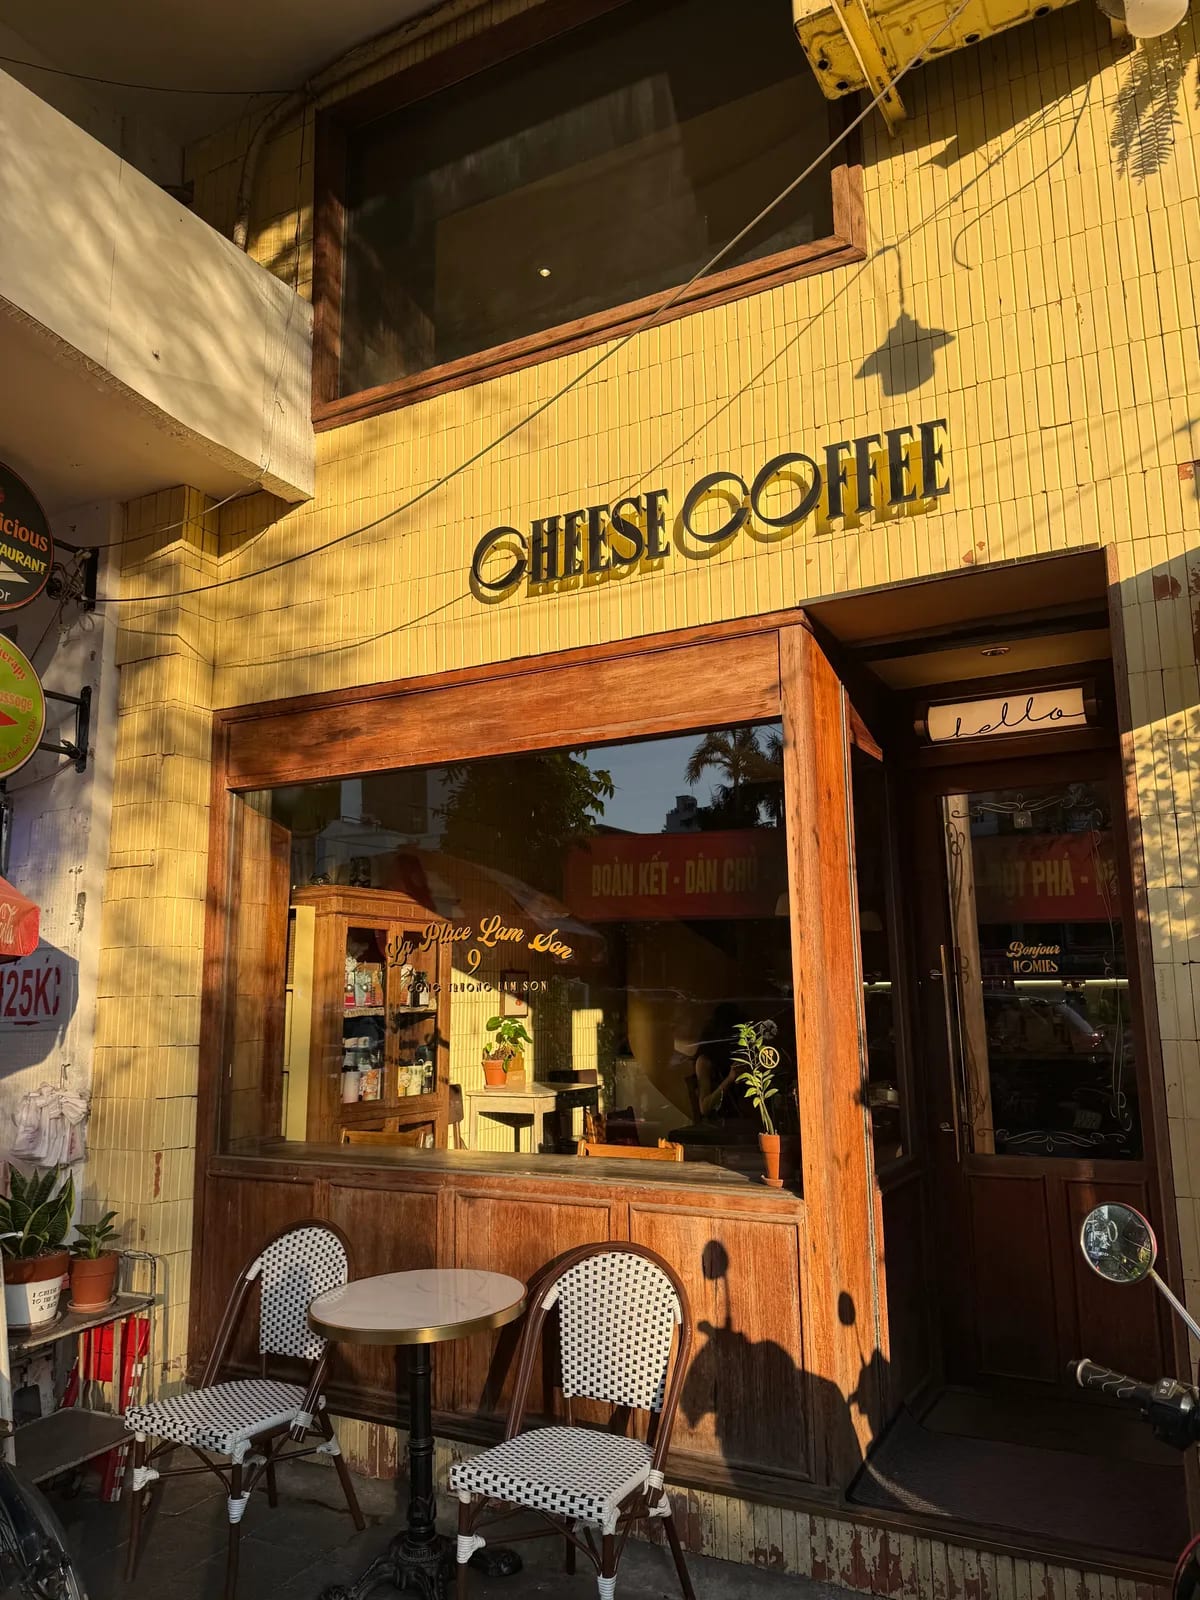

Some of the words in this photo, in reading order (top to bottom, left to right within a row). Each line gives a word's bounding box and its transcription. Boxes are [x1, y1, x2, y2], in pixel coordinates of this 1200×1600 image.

[472, 488, 671, 592] CHEESE
[683, 418, 950, 544] COFFEE
[0, 542, 48, 576] AURANT
[933, 697, 1086, 741] hello
[1032, 852, 1076, 897] PHÁ
[385, 935, 413, 967] La
[420, 922, 473, 952] Place
[477, 915, 525, 948] Lam
[528, 928, 575, 960] Son
[1006, 941, 1061, 959] Bonjour
[467, 949, 482, 976] 9
[1013, 960, 1059, 974] HOMIES
[522, 981, 549, 992] SON
